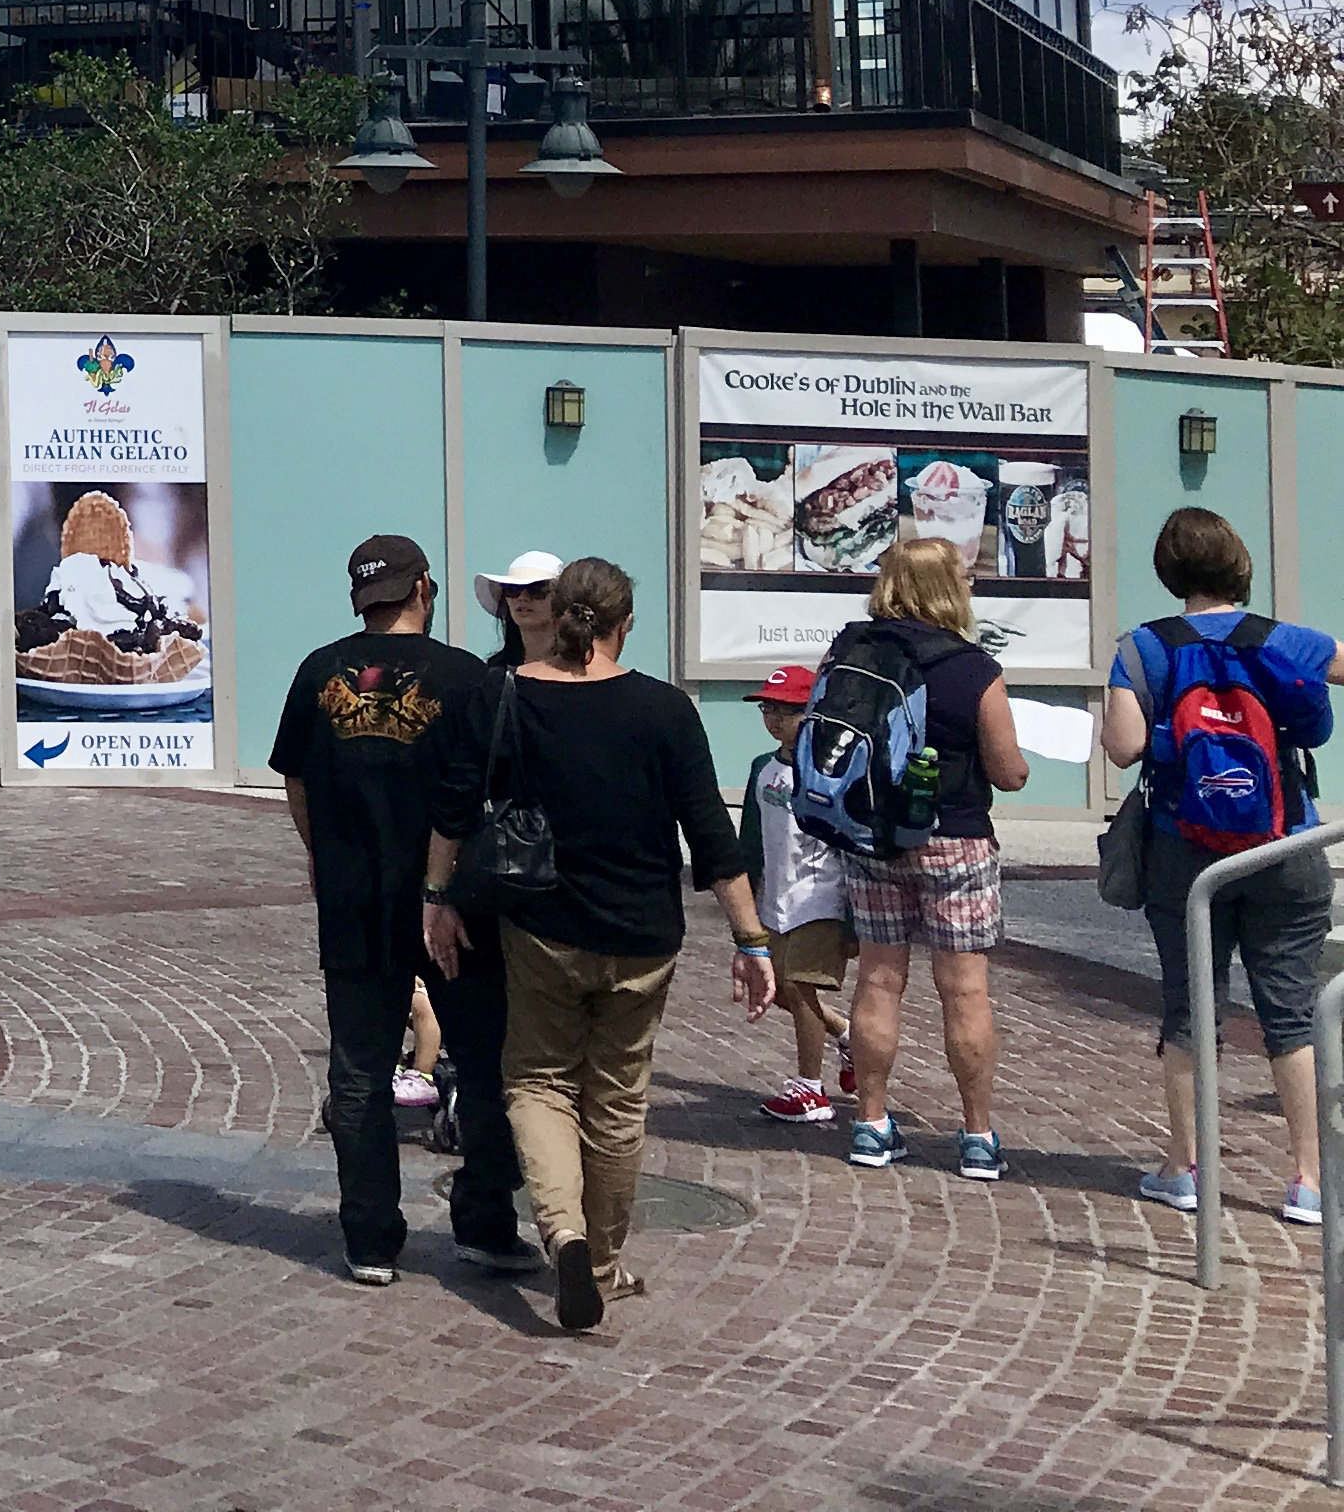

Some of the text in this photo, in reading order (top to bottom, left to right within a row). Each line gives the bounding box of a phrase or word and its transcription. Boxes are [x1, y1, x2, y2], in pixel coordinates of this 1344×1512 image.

[724, 369, 972, 399] Cooke's of Dublin and the
[840, 397, 1053, 423] Hole in the Wall Bar
[49, 429, 164, 444] AUTHENTIC
[24, 444, 188, 461] ITALIAN GELATO
[22, 463, 62, 473] DIRECT
[64, 463, 97, 474] FROM
[162, 464, 190, 475] ITALY
[758, 624, 838, 644] Just arou
[81, 734, 194, 749] OPEN DAILY
[89, 752, 188, 767] AT 10 A.M.
